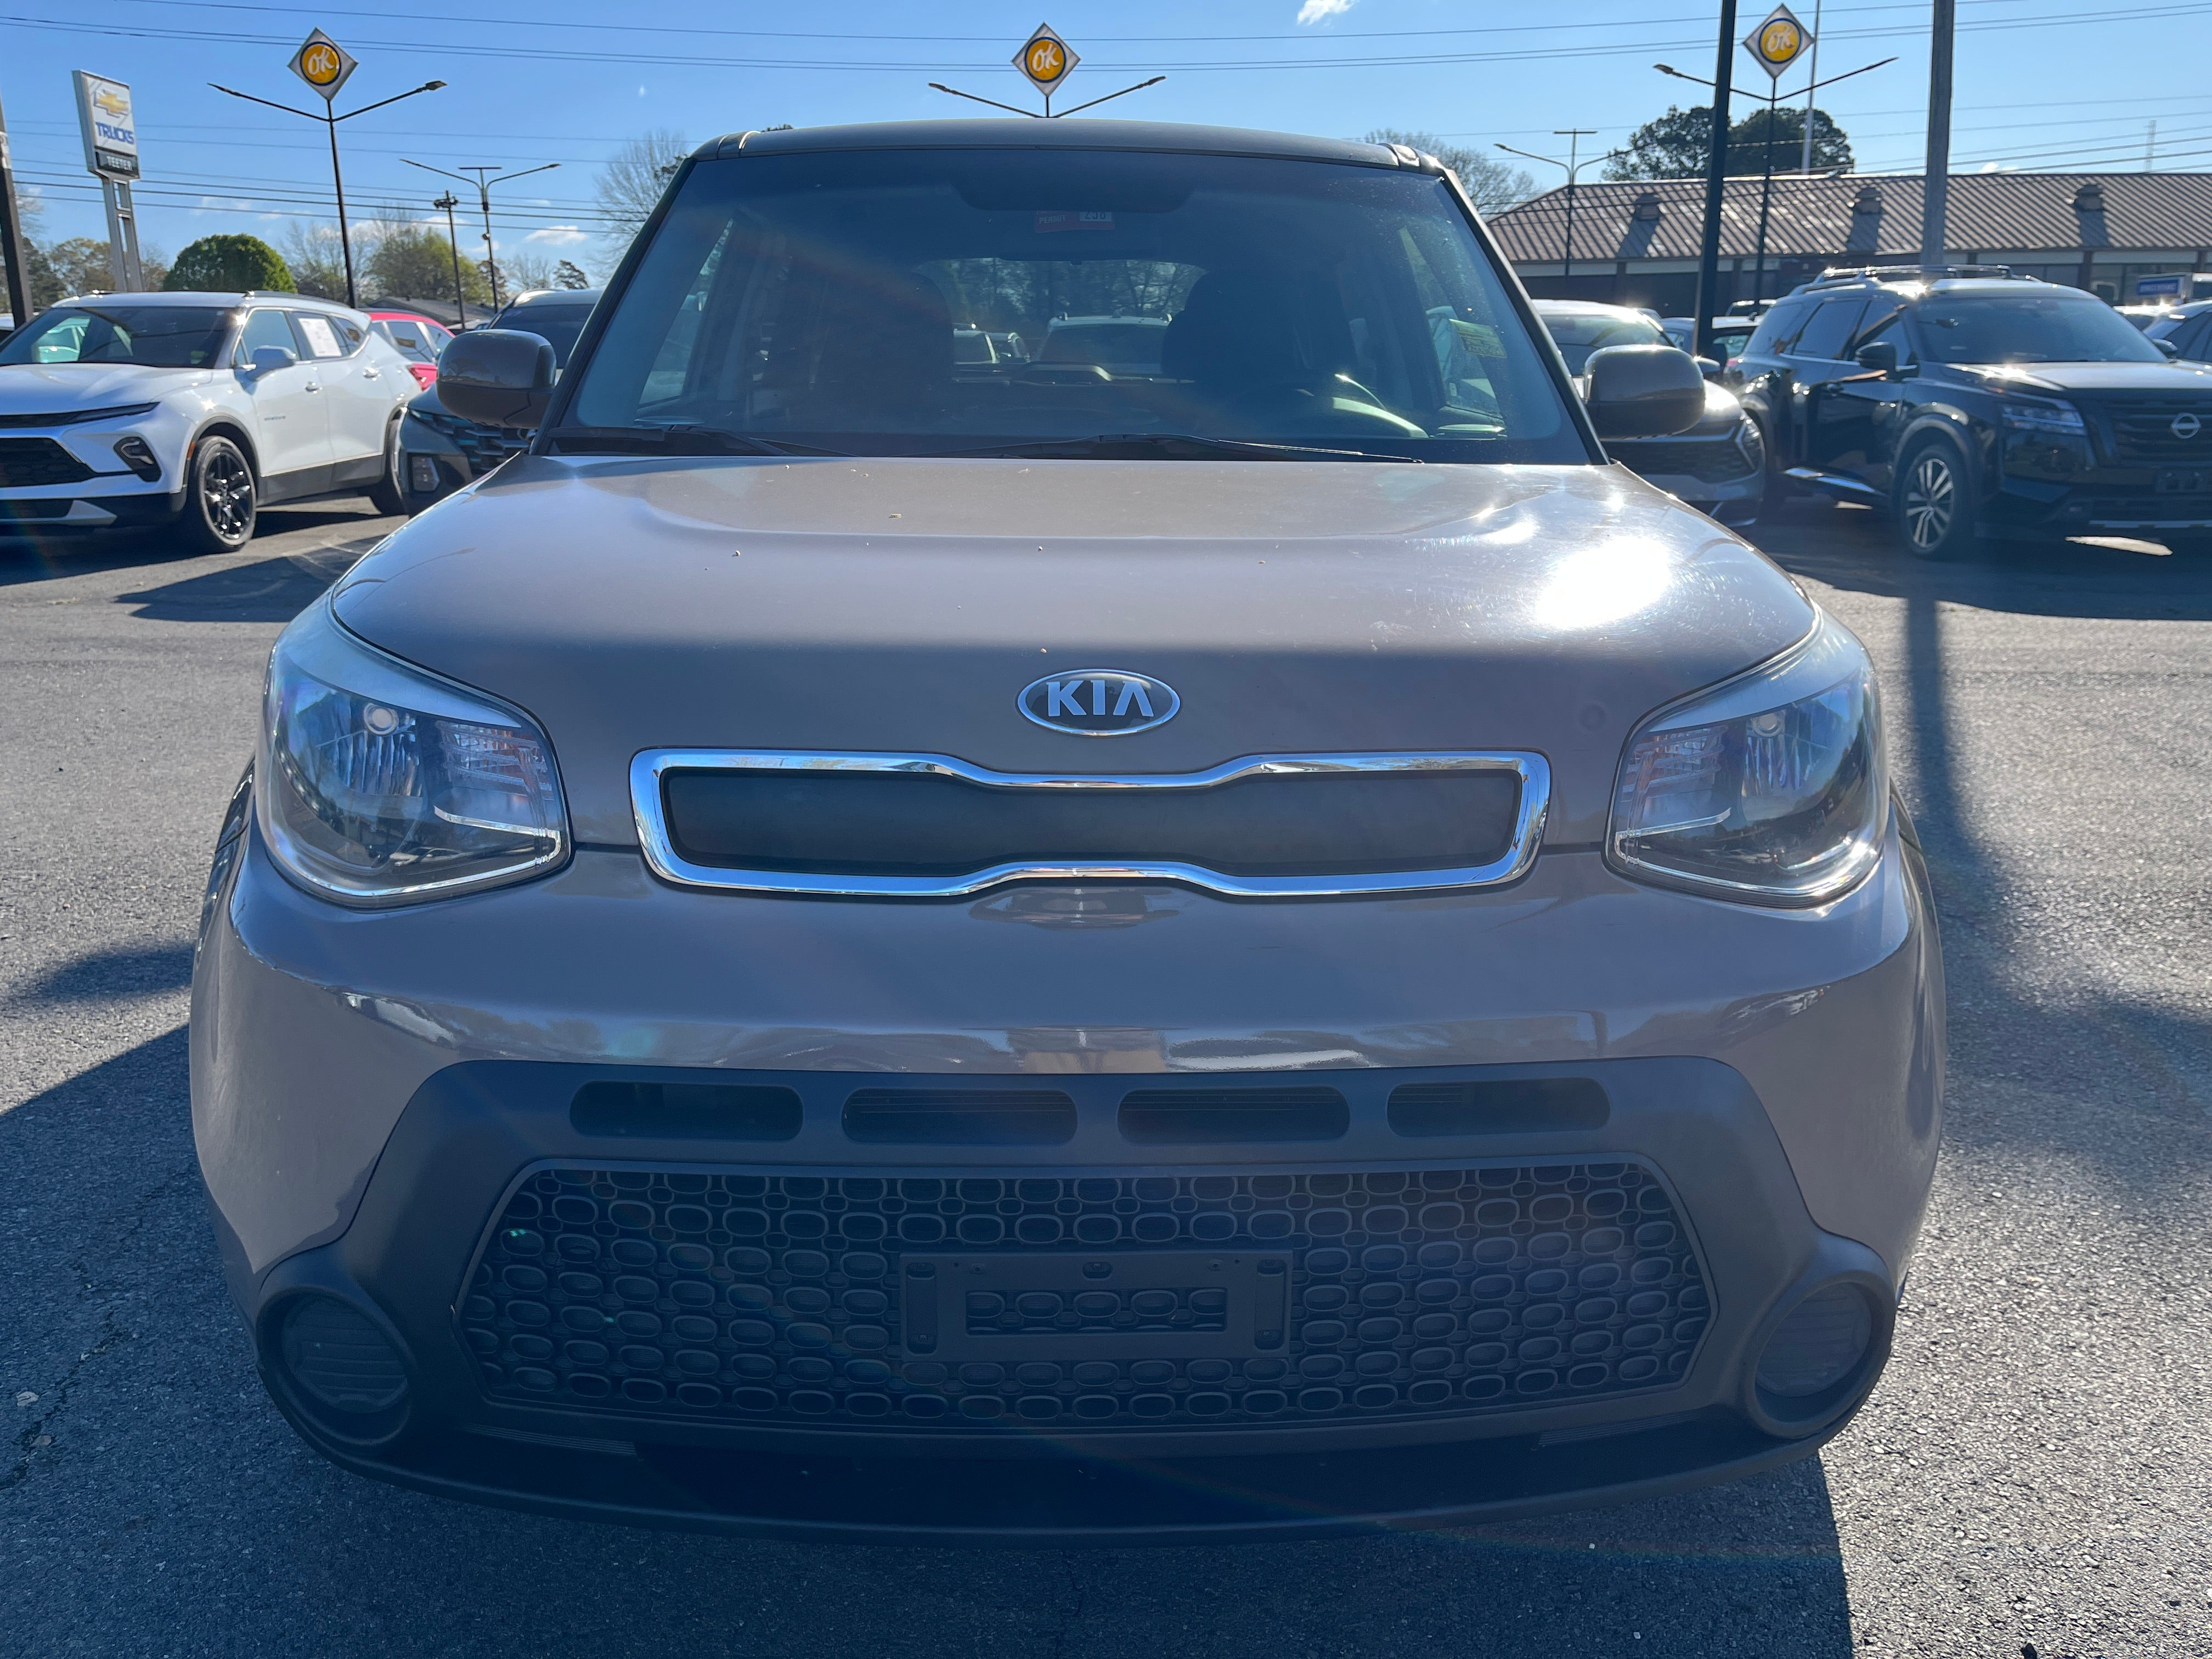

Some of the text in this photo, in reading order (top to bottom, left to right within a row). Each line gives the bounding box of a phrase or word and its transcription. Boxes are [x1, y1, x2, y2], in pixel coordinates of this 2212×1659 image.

[1767, 25, 1794, 53] OK
[308, 47, 335, 75] OK
[1031, 43, 1059, 72] OK
[95, 122, 134, 145] TRUCKS
[1039, 215, 1066, 224] PERMIT
[1046, 680, 1154, 716] KIA
